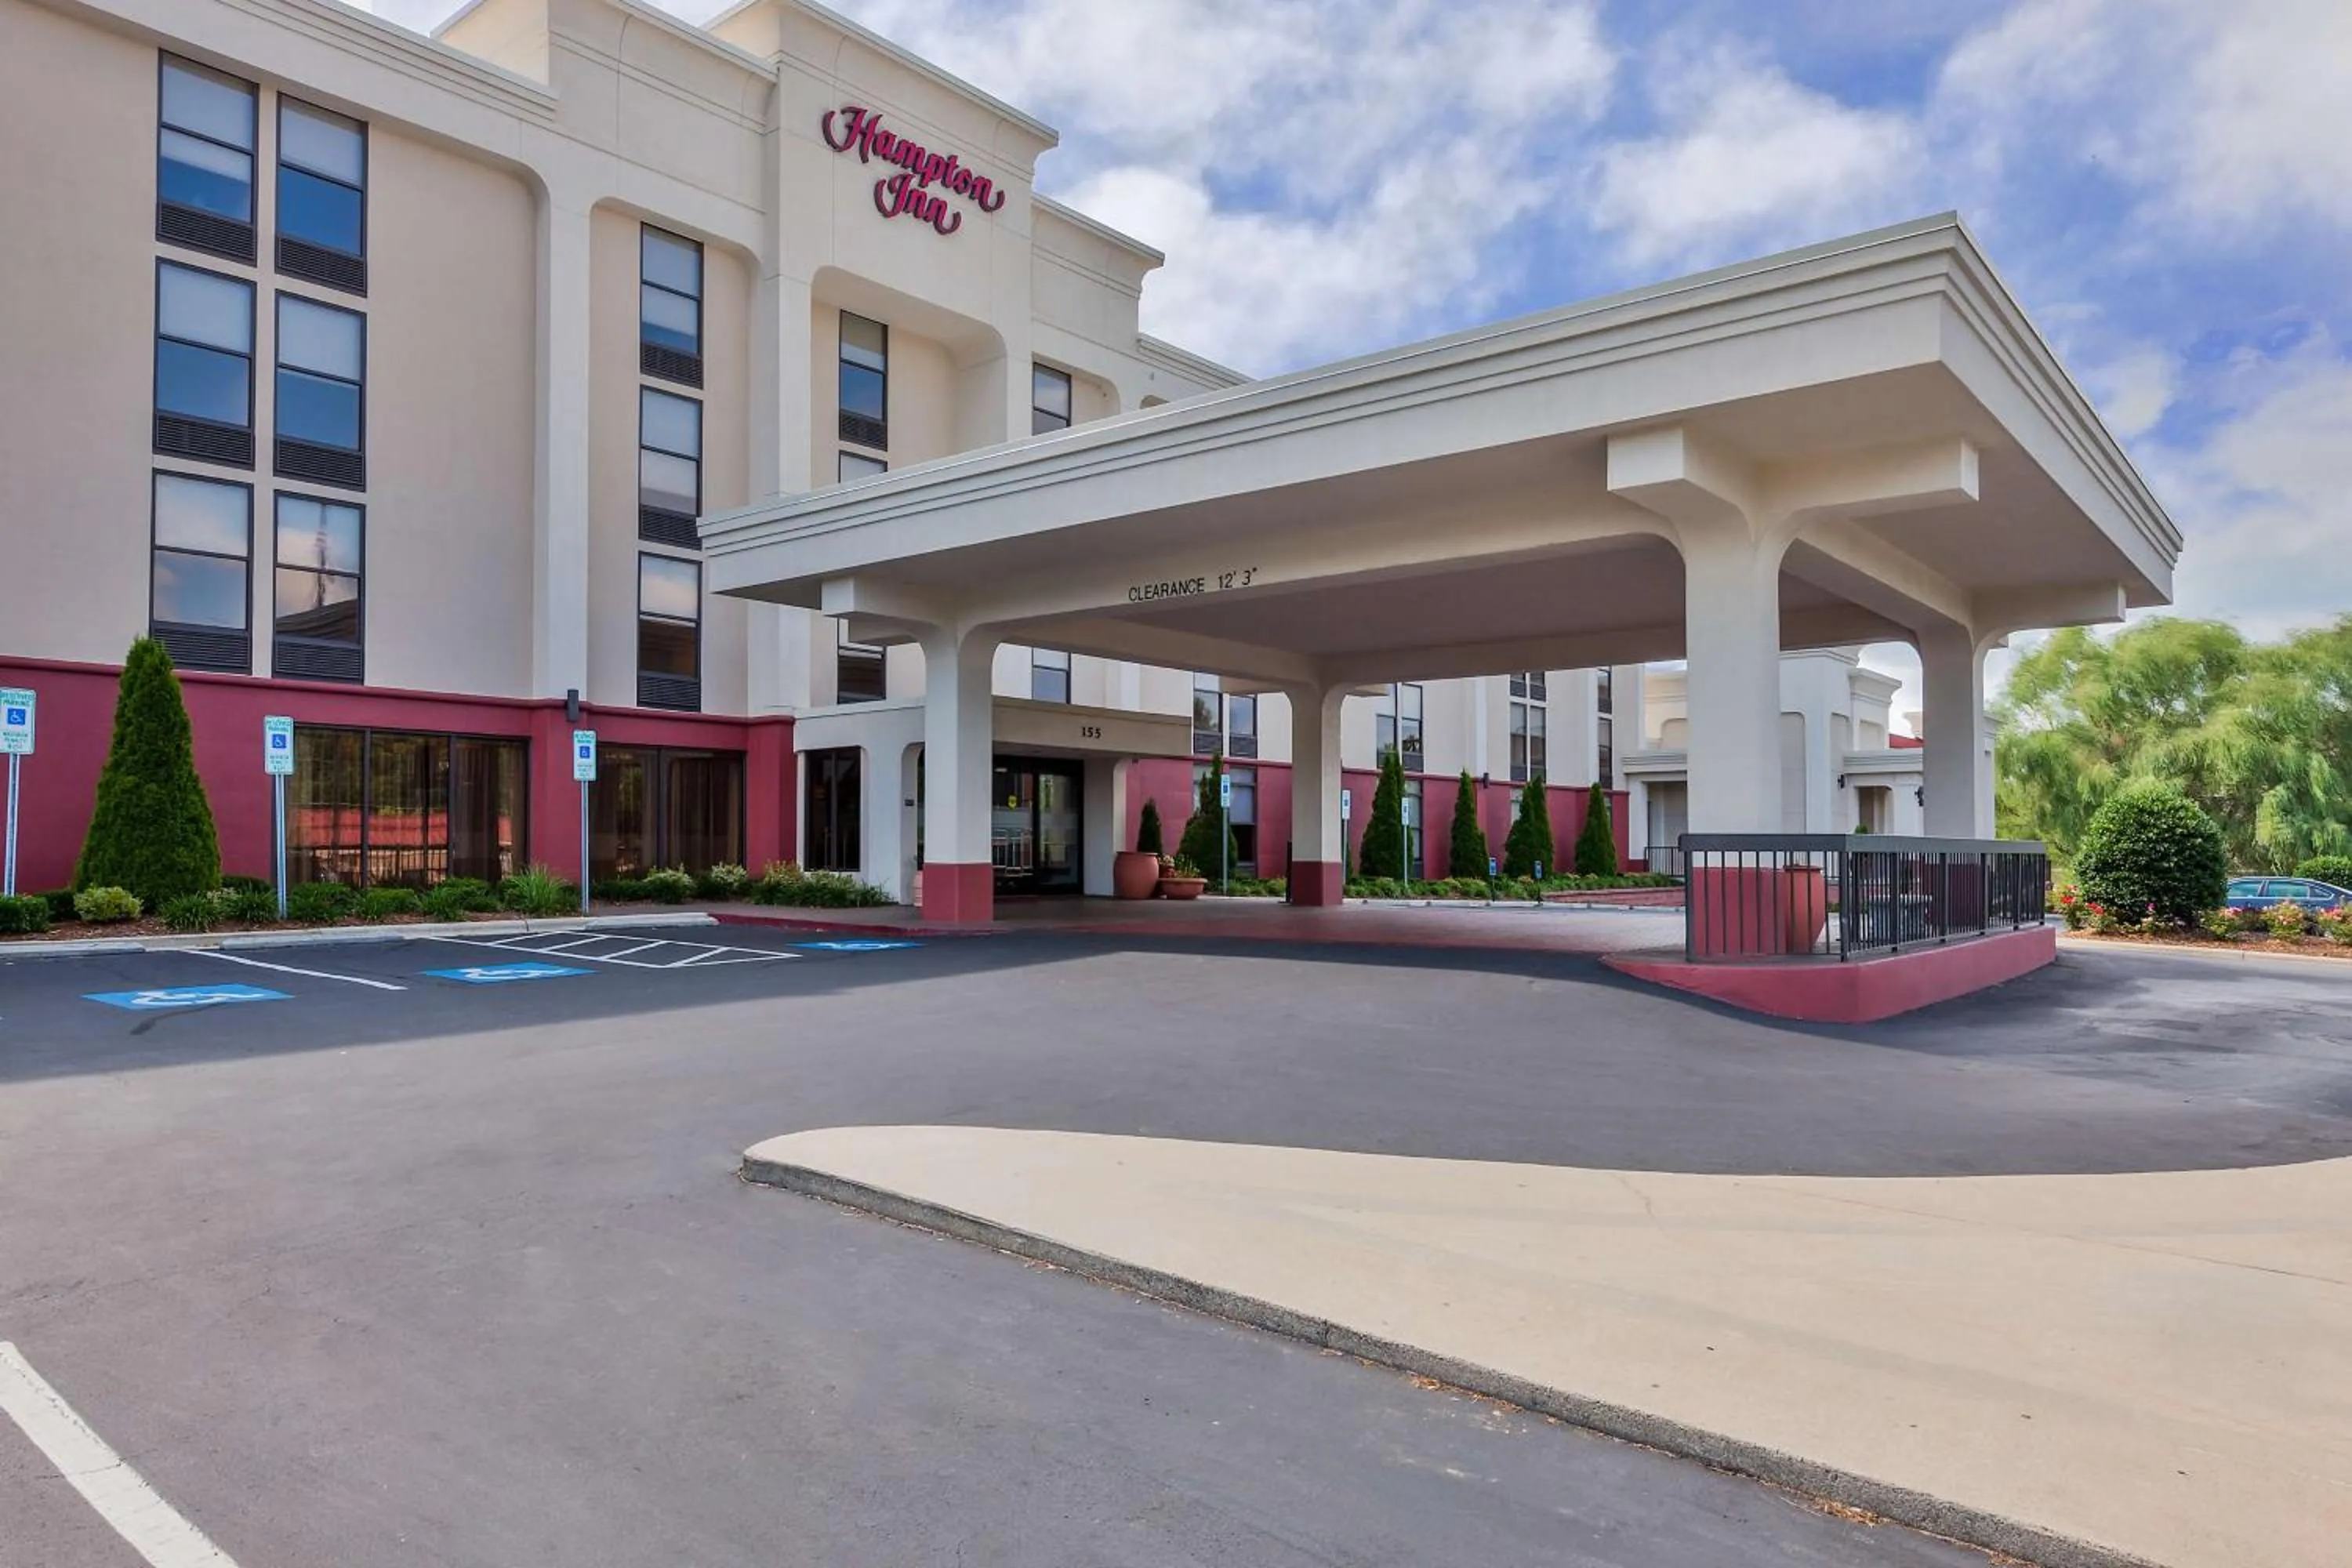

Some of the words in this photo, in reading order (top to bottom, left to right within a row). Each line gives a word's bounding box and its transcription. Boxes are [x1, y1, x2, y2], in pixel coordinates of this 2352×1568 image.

[822, 106, 1006, 212] Hampton
[873, 172, 962, 235] Inn
[1128, 578, 1205, 602] CLEARANCE
[1083, 727, 1102, 739] 155
